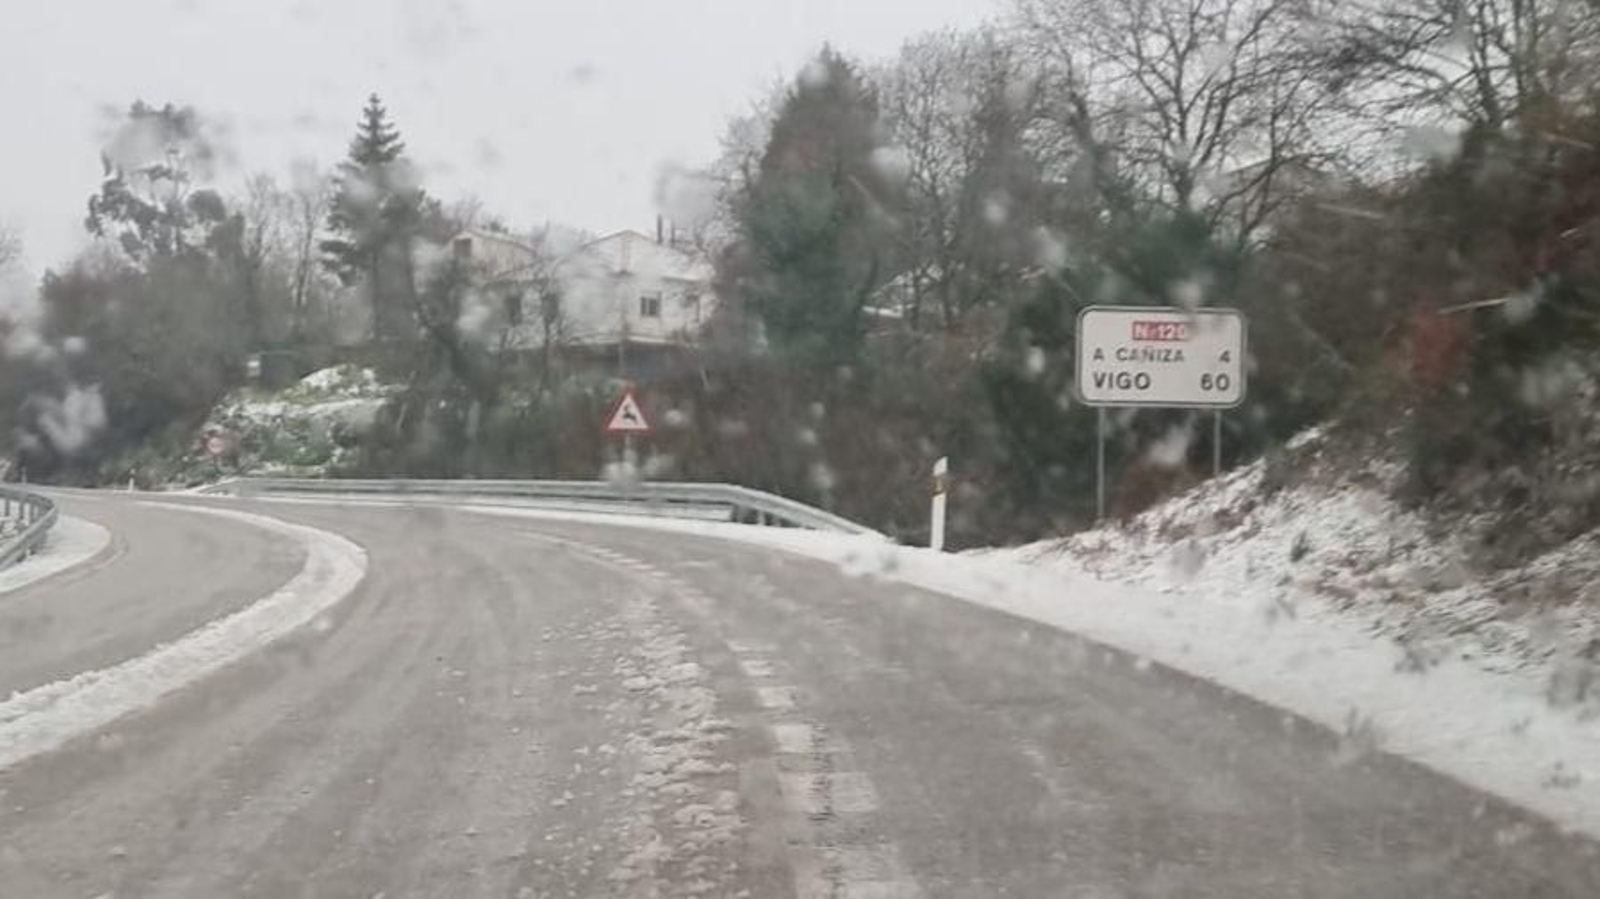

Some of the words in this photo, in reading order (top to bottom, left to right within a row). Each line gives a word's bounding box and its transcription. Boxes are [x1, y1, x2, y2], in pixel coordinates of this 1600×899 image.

[1093, 347, 1105, 361] A
[1116, 346, 1185, 363] CAÑIZA
[1219, 350, 1231, 363] 4
[1093, 372, 1151, 390] VIGO
[1201, 373, 1231, 391] 60
